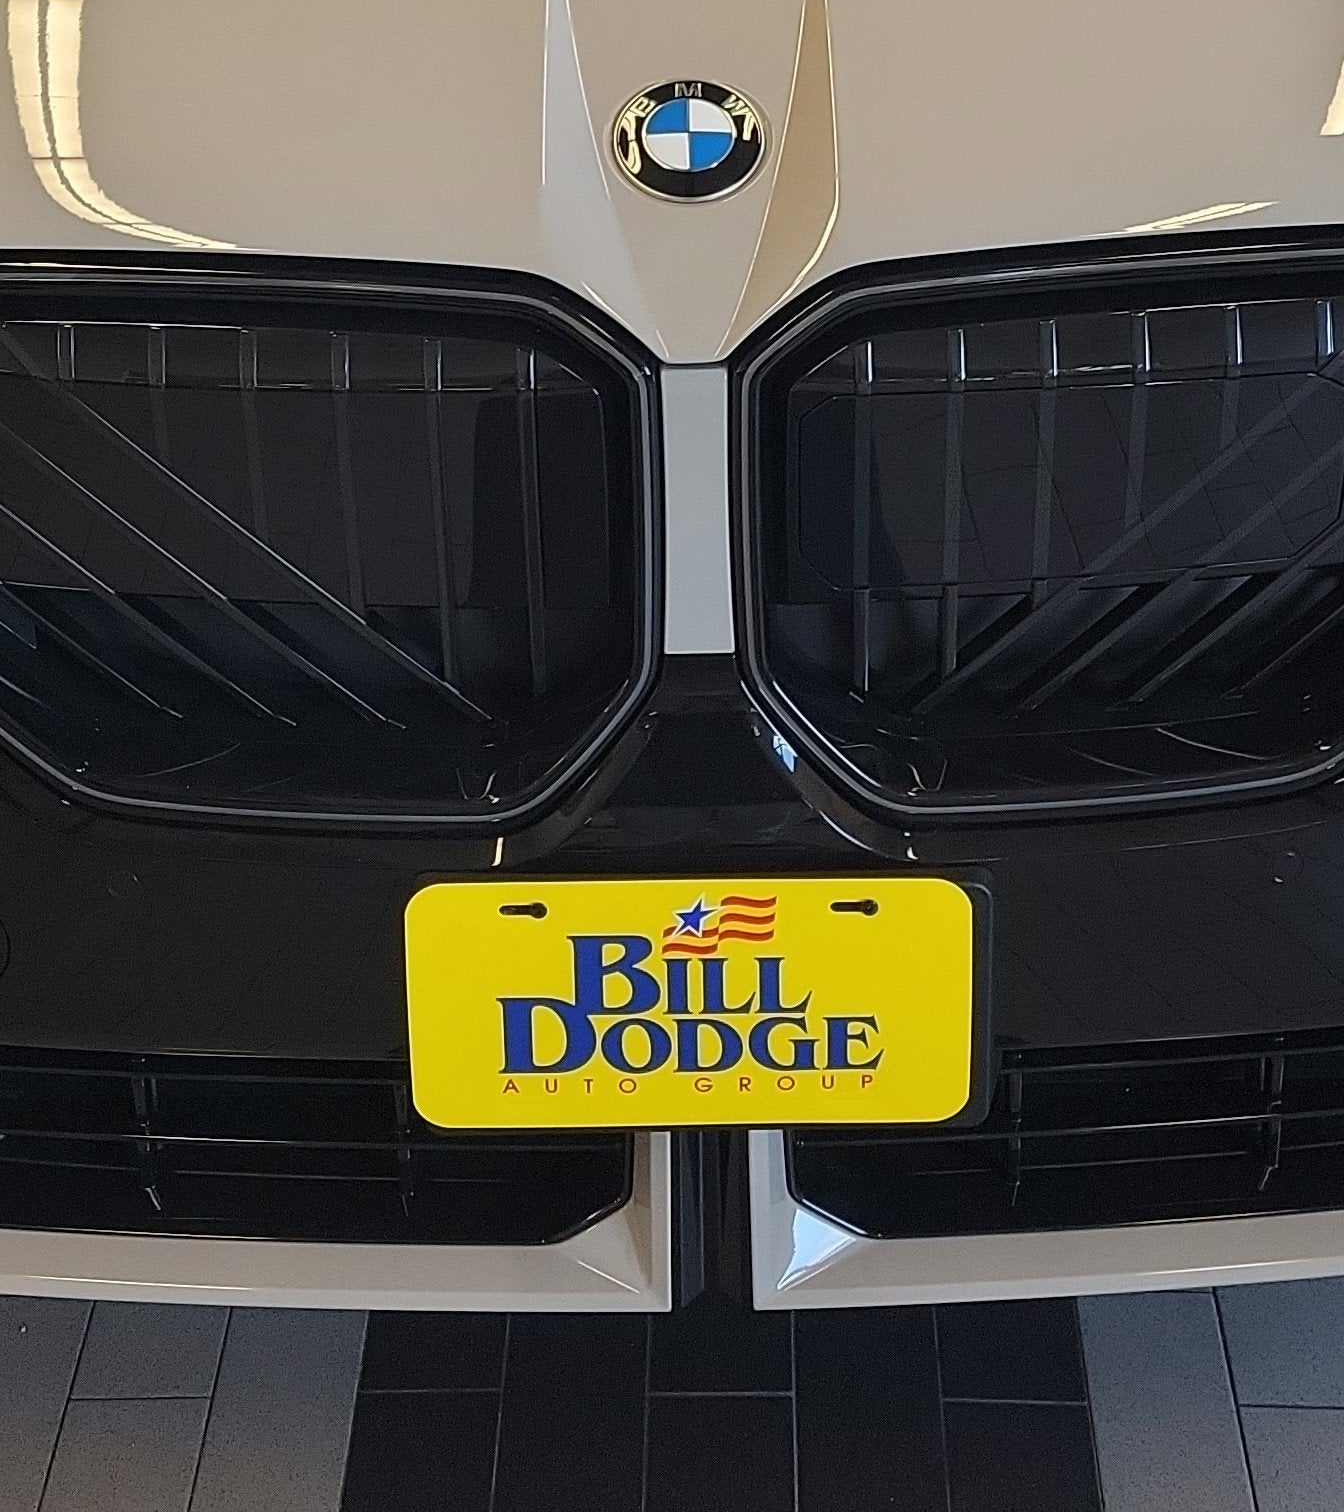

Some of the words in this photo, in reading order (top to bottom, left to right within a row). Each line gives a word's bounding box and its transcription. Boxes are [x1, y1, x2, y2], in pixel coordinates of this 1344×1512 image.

[566, 934, 813, 1016] BILL
[496, 997, 885, 1074] DODGE
[502, 1078, 638, 1095] AUTO
[694, 1074, 876, 1094] GROUP
